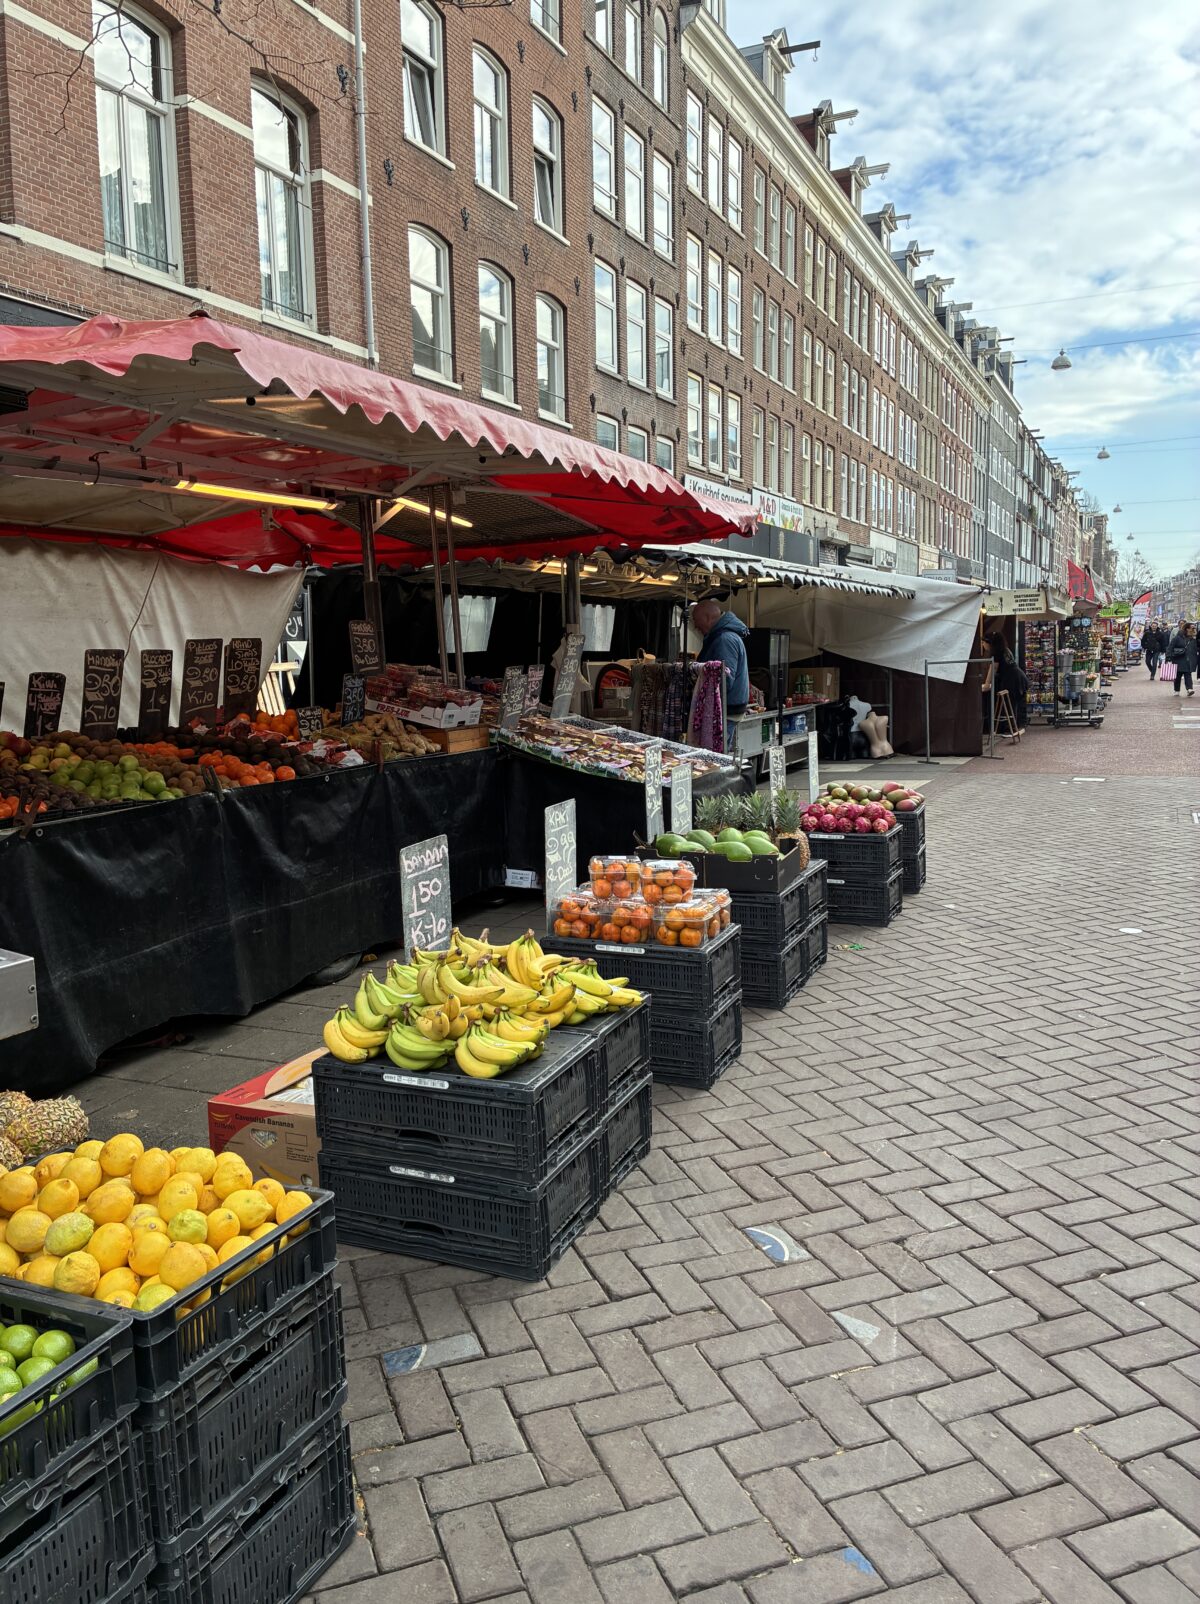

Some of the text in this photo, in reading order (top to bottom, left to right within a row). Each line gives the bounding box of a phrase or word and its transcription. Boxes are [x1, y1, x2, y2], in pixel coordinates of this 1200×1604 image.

[759, 495, 777, 516] M&D
[354, 638, 376, 653] 350
[187, 690, 214, 704] Kilo
[84, 704, 116, 721] Kilo
[408, 878, 442, 918] 150
[411, 911, 447, 947] Kilo
[234, 1112, 295, 1129] Cavendish Bananas
